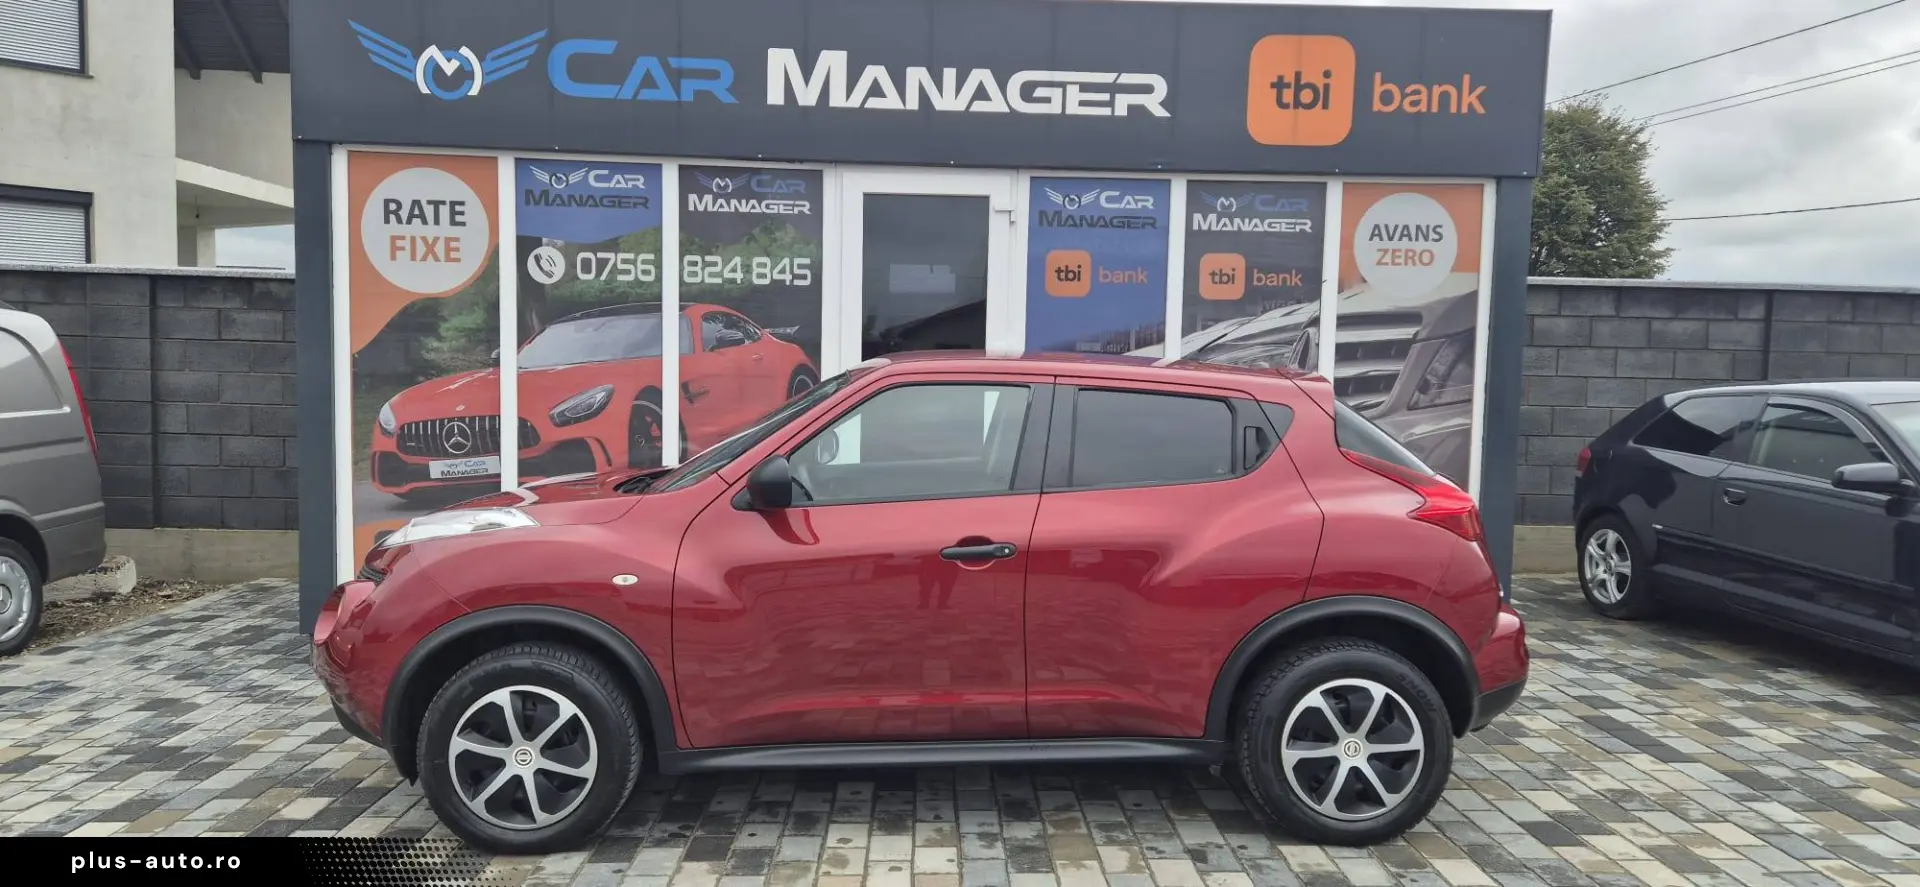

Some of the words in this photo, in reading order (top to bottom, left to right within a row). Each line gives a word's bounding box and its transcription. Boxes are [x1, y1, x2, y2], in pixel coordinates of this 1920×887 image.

[547, 38, 739, 104] CAR
[766, 47, 1171, 117] MANAGER
[1270, 69, 1333, 111] tbi
[1371, 71, 1487, 114] bank
[588, 169, 646, 189] CAR
[524, 188, 650, 210] MANAGER
[687, 193, 812, 215] MANAGER
[1100, 190, 1154, 209] CAR
[383, 198, 467, 227] RATE
[1038, 209, 1158, 230] MANAGER
[1192, 213, 1313, 233] MANAGER
[1368, 224, 1444, 243] AVANS
[389, 235, 462, 263] FIXE
[1375, 248, 1435, 267] ZERO
[576, 251, 656, 282] 0756
[683, 255, 744, 284] 824
[752, 256, 811, 286] 845
[1054, 264, 1082, 282] tbi
[1099, 266, 1148, 284] bank
[1208, 267, 1236, 285] tbi
[1253, 269, 1303, 287] bank
